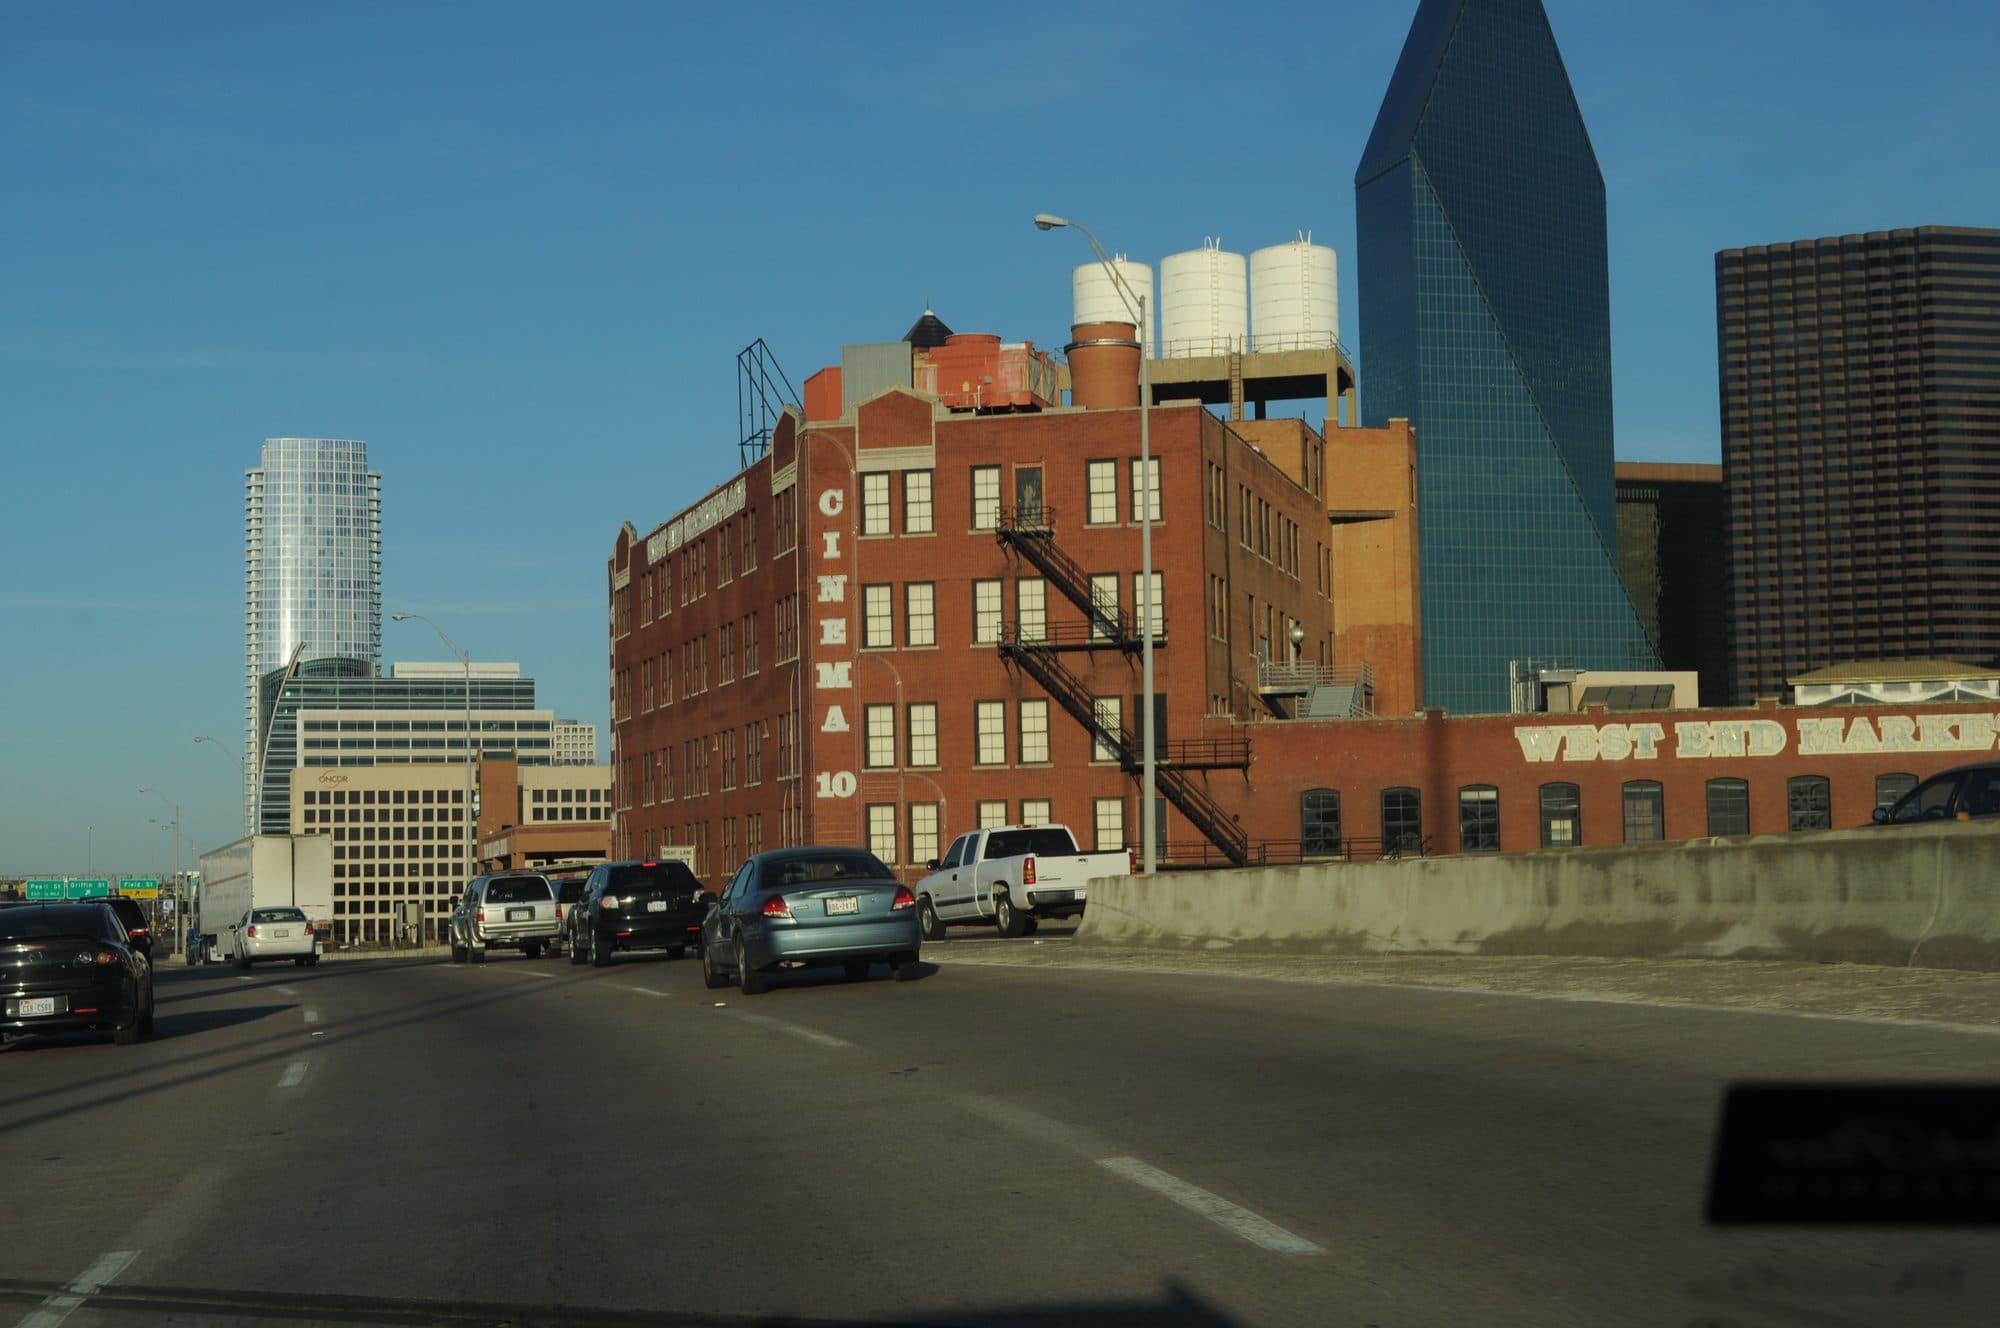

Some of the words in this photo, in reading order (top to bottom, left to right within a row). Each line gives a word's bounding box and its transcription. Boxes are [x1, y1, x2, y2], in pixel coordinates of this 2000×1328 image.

[816, 488, 853, 733] CINEMA
[1514, 723, 1665, 763] WEST
[1675, 719, 1787, 759] END
[1796, 713, 2000, 756] MARKE
[319, 775, 348, 784] ONCOR
[816, 770, 857, 798] 10
